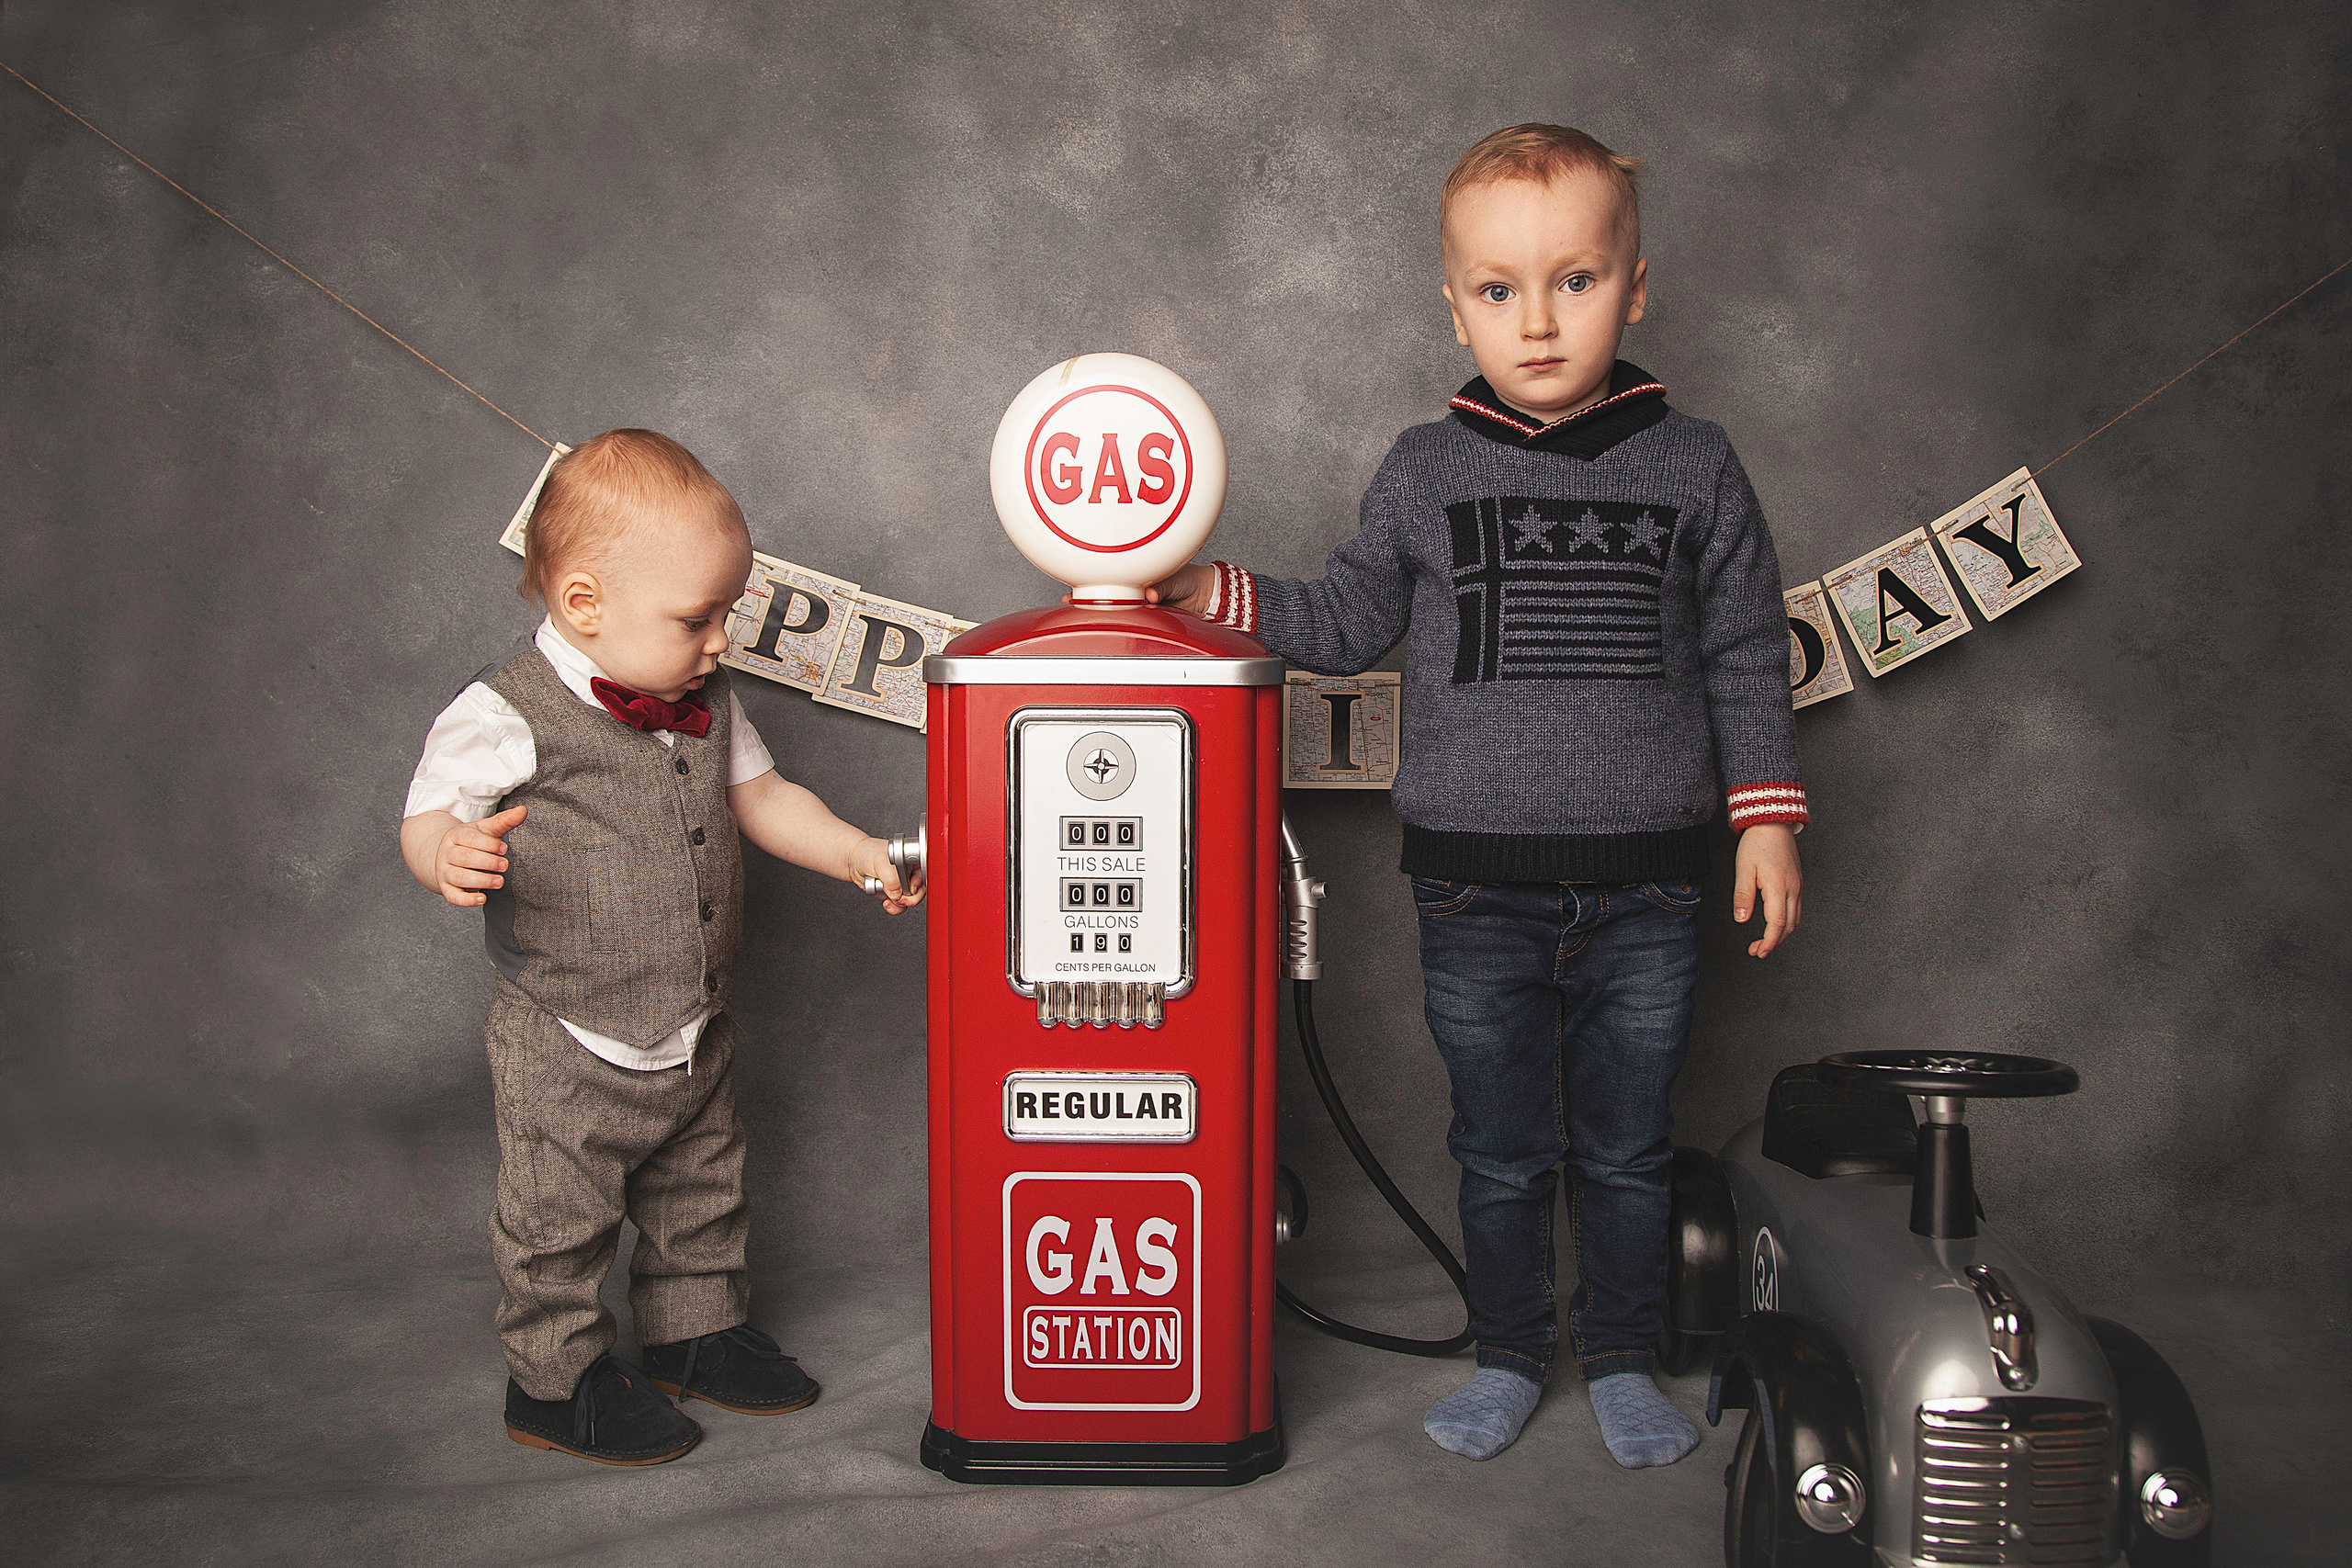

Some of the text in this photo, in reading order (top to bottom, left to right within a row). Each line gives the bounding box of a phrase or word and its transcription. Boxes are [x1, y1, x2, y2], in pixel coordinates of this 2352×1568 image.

[1040, 432, 1175, 505] GAS
[1057, 857, 1147, 872] THIS SALE
[1064, 916, 1139, 929] GALLONS
[1055, 963, 1156, 972] CENTS PER GALLON
[1016, 1092, 1182, 1119] REGULAR
[1025, 1215, 1178, 1296] GAS
[1031, 1315, 1176, 1360] STATION
